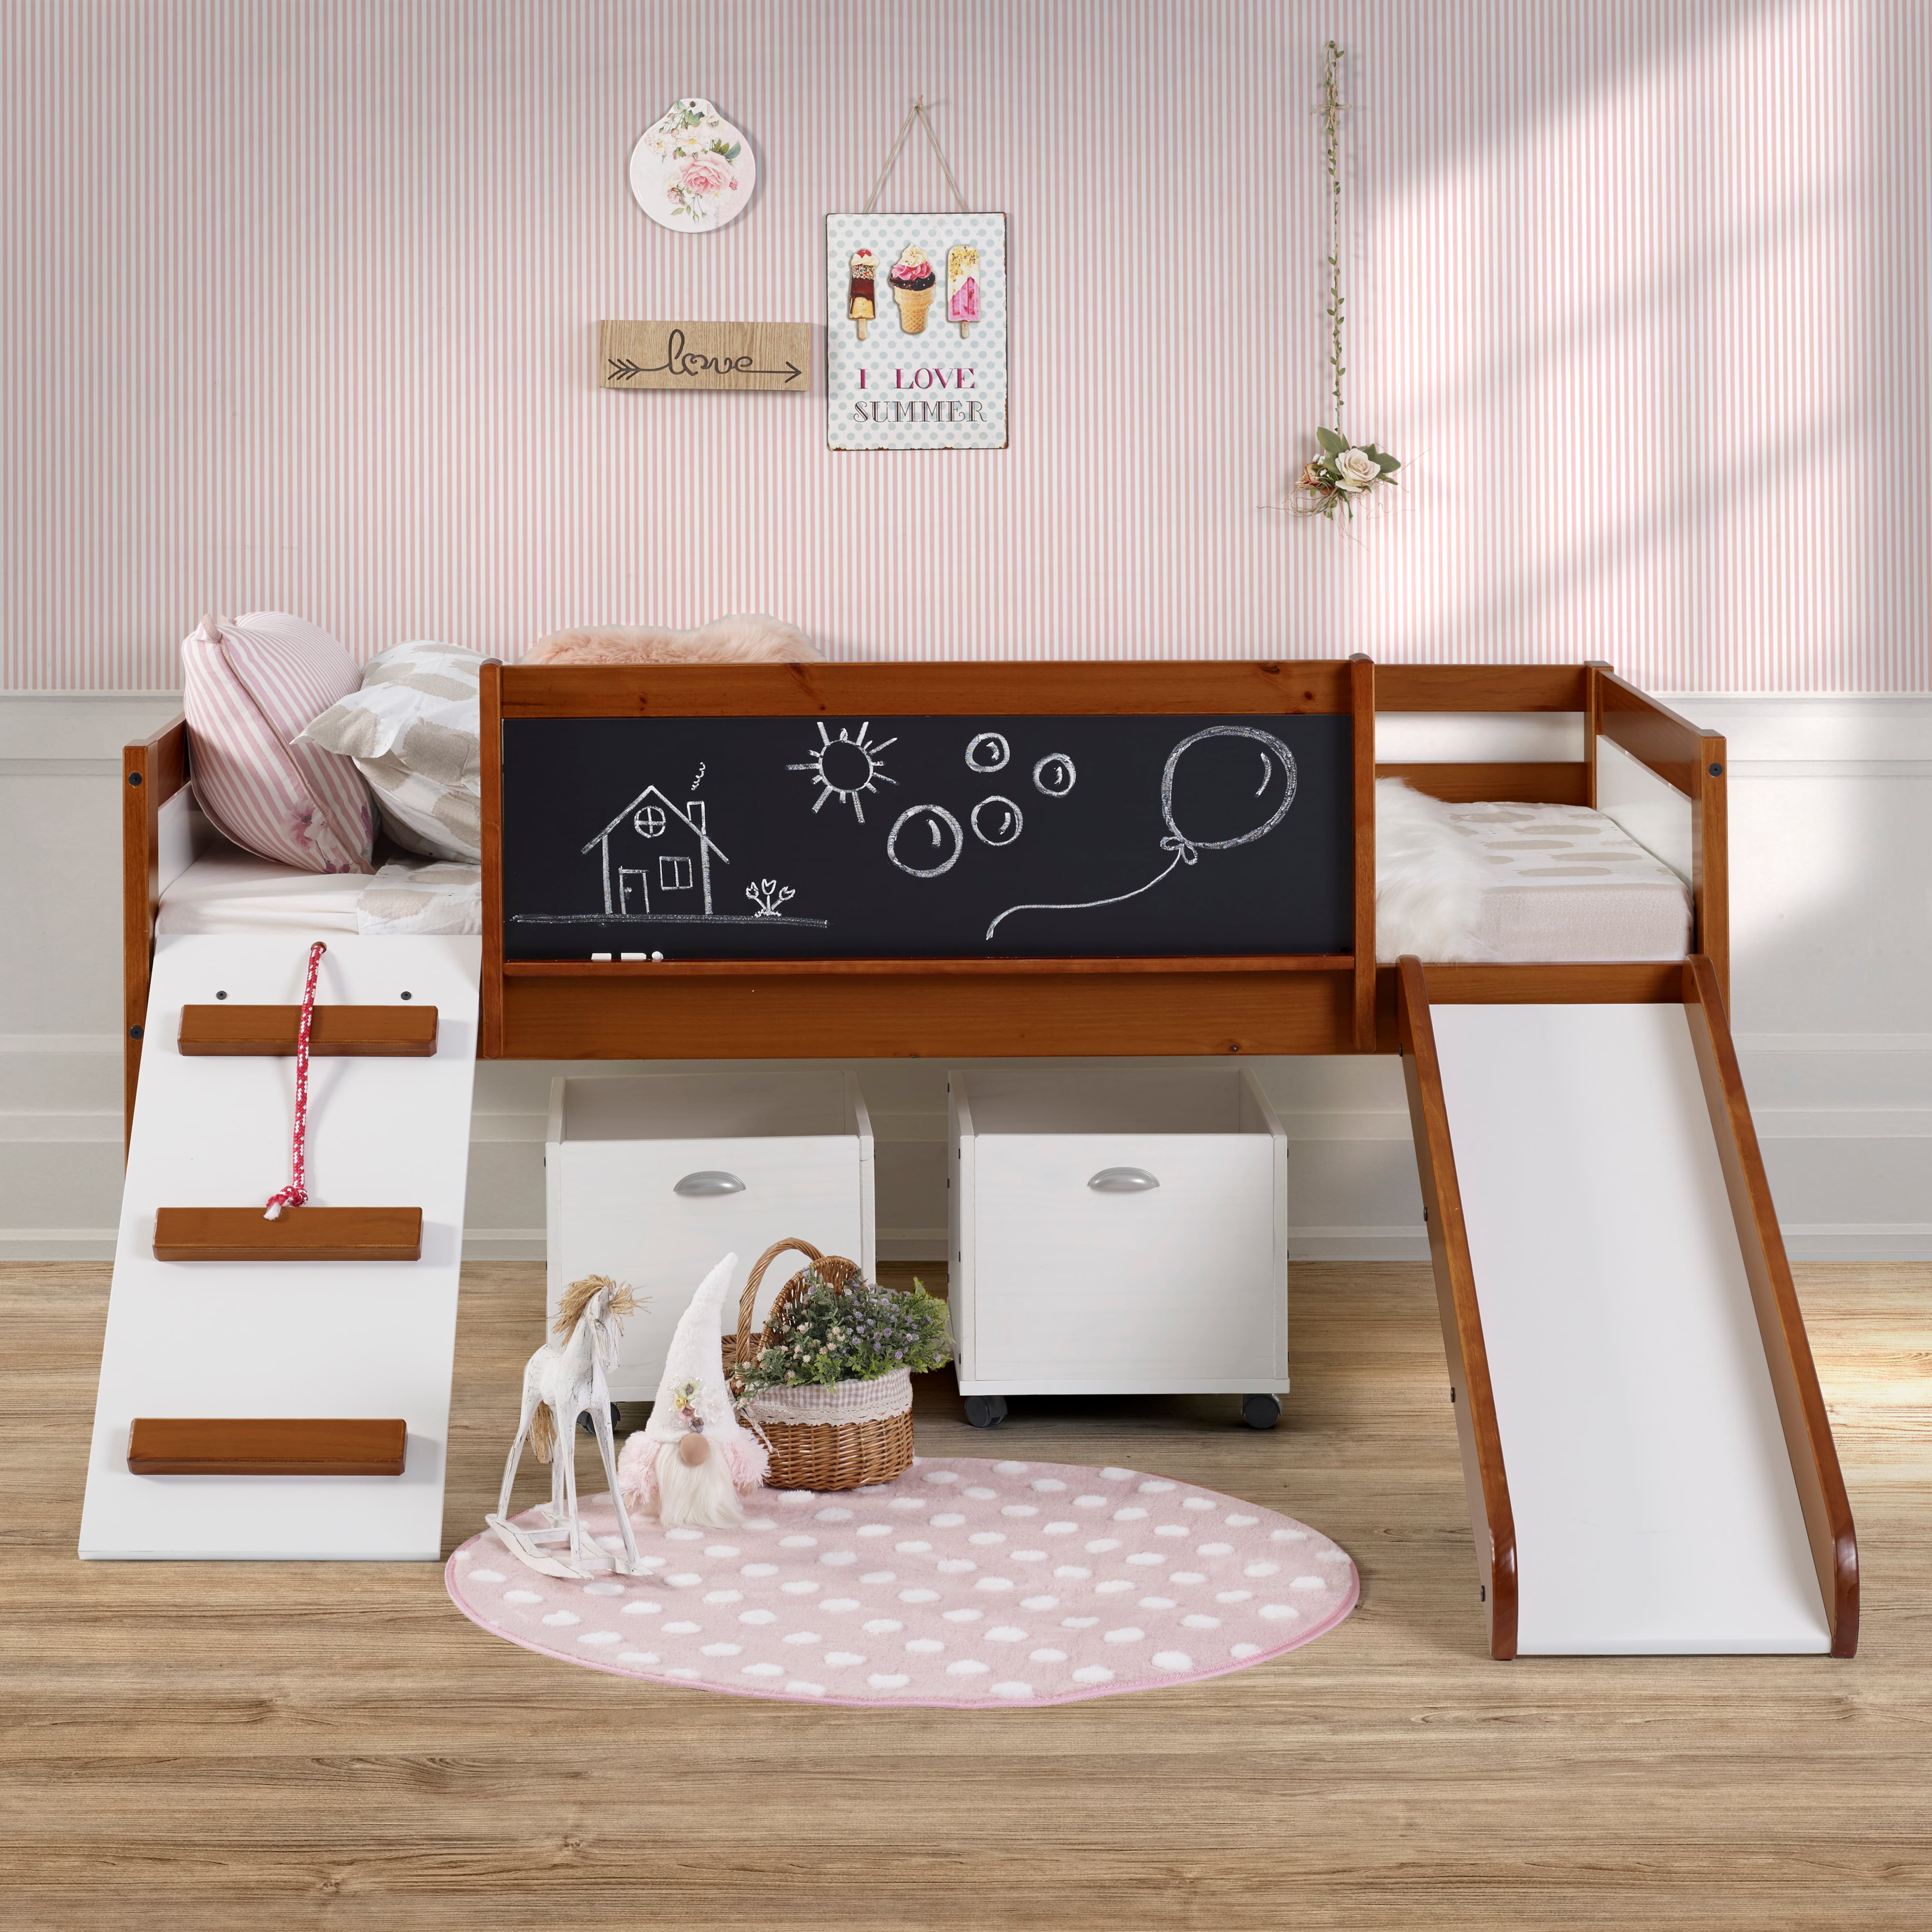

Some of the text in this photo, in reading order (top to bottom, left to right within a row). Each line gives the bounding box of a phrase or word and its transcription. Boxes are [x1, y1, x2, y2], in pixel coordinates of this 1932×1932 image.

[858, 368, 975, 389] I LOVE
[853, 400, 987, 423] SUMMER
